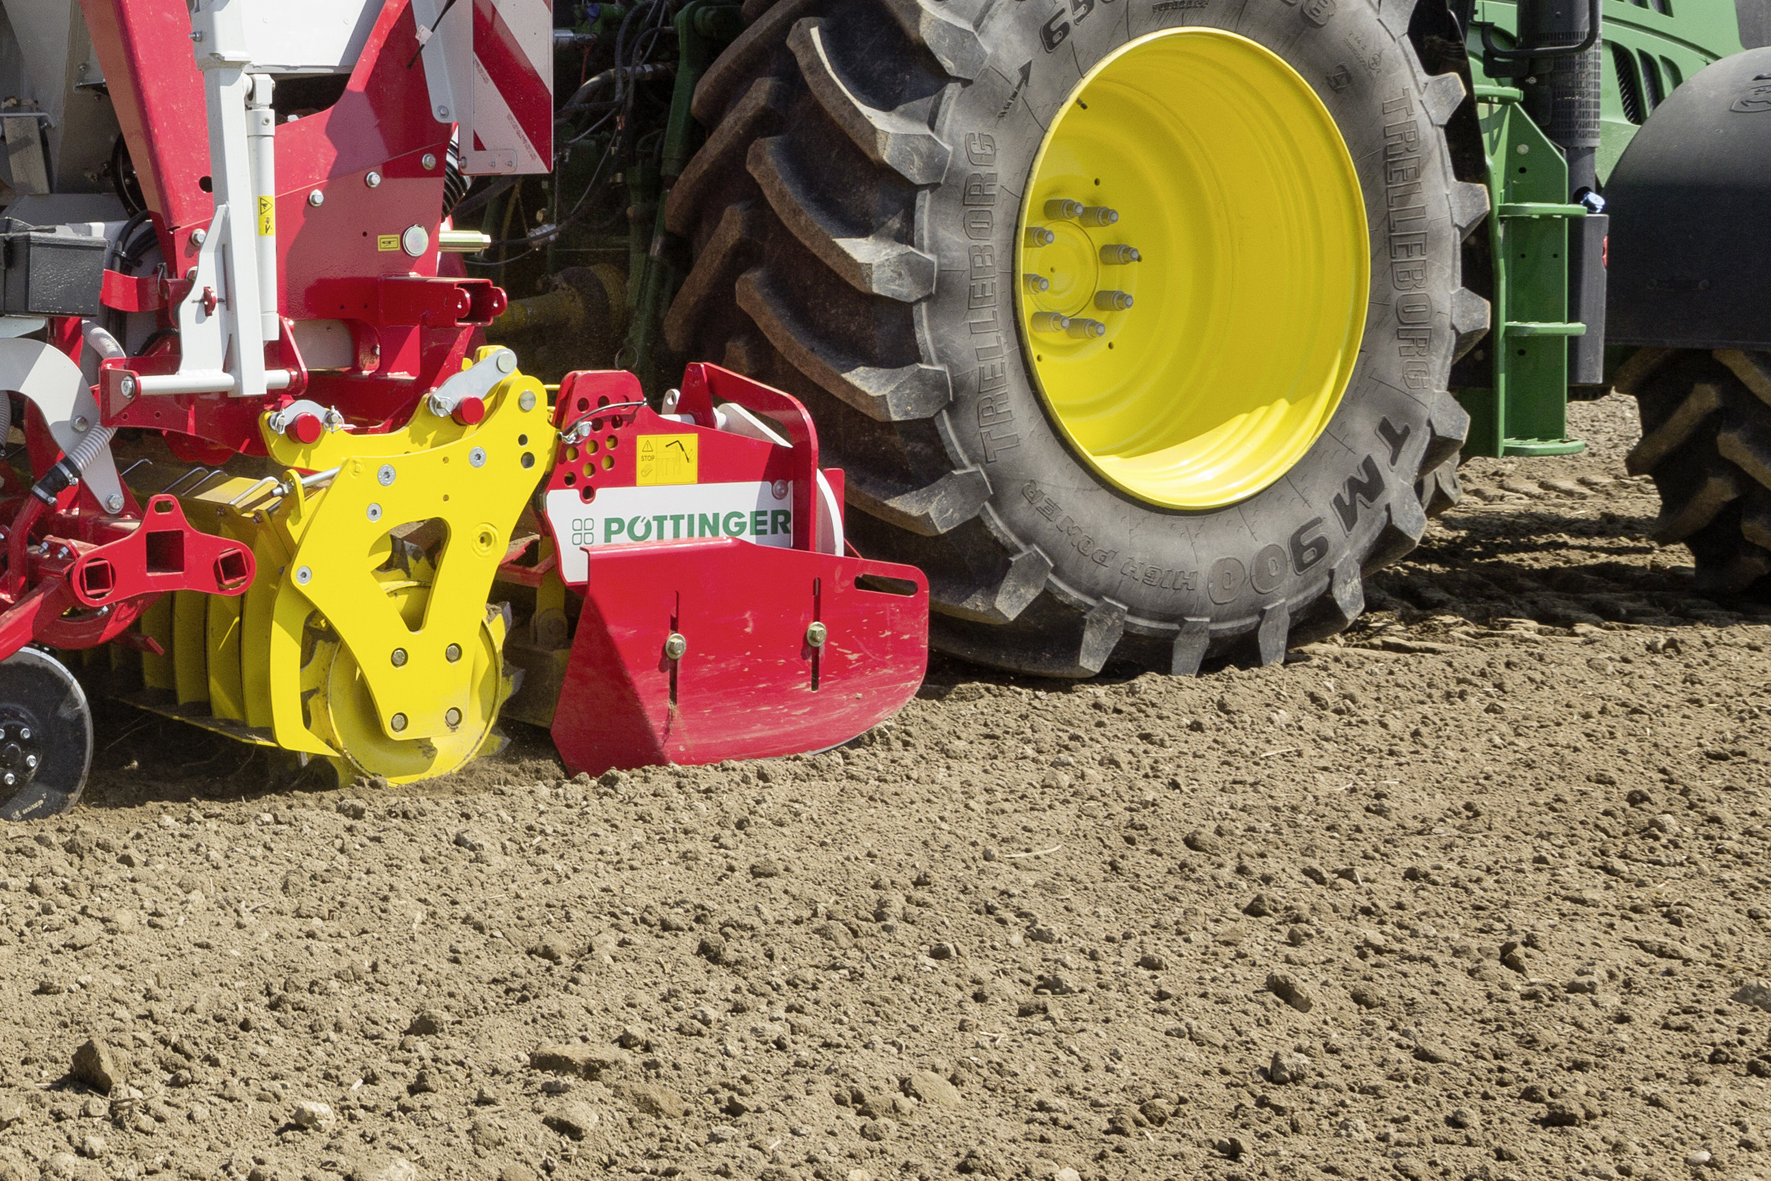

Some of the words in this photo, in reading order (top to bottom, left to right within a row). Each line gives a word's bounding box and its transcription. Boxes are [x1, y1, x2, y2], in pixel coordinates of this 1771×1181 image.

[963, 132, 1021, 463] TRELLEBORG
[1382, 87, 1433, 390] TRELLEBORG
[604, 510, 791, 543] PÖTTINGER
[641, 454, 655, 462] STOP
